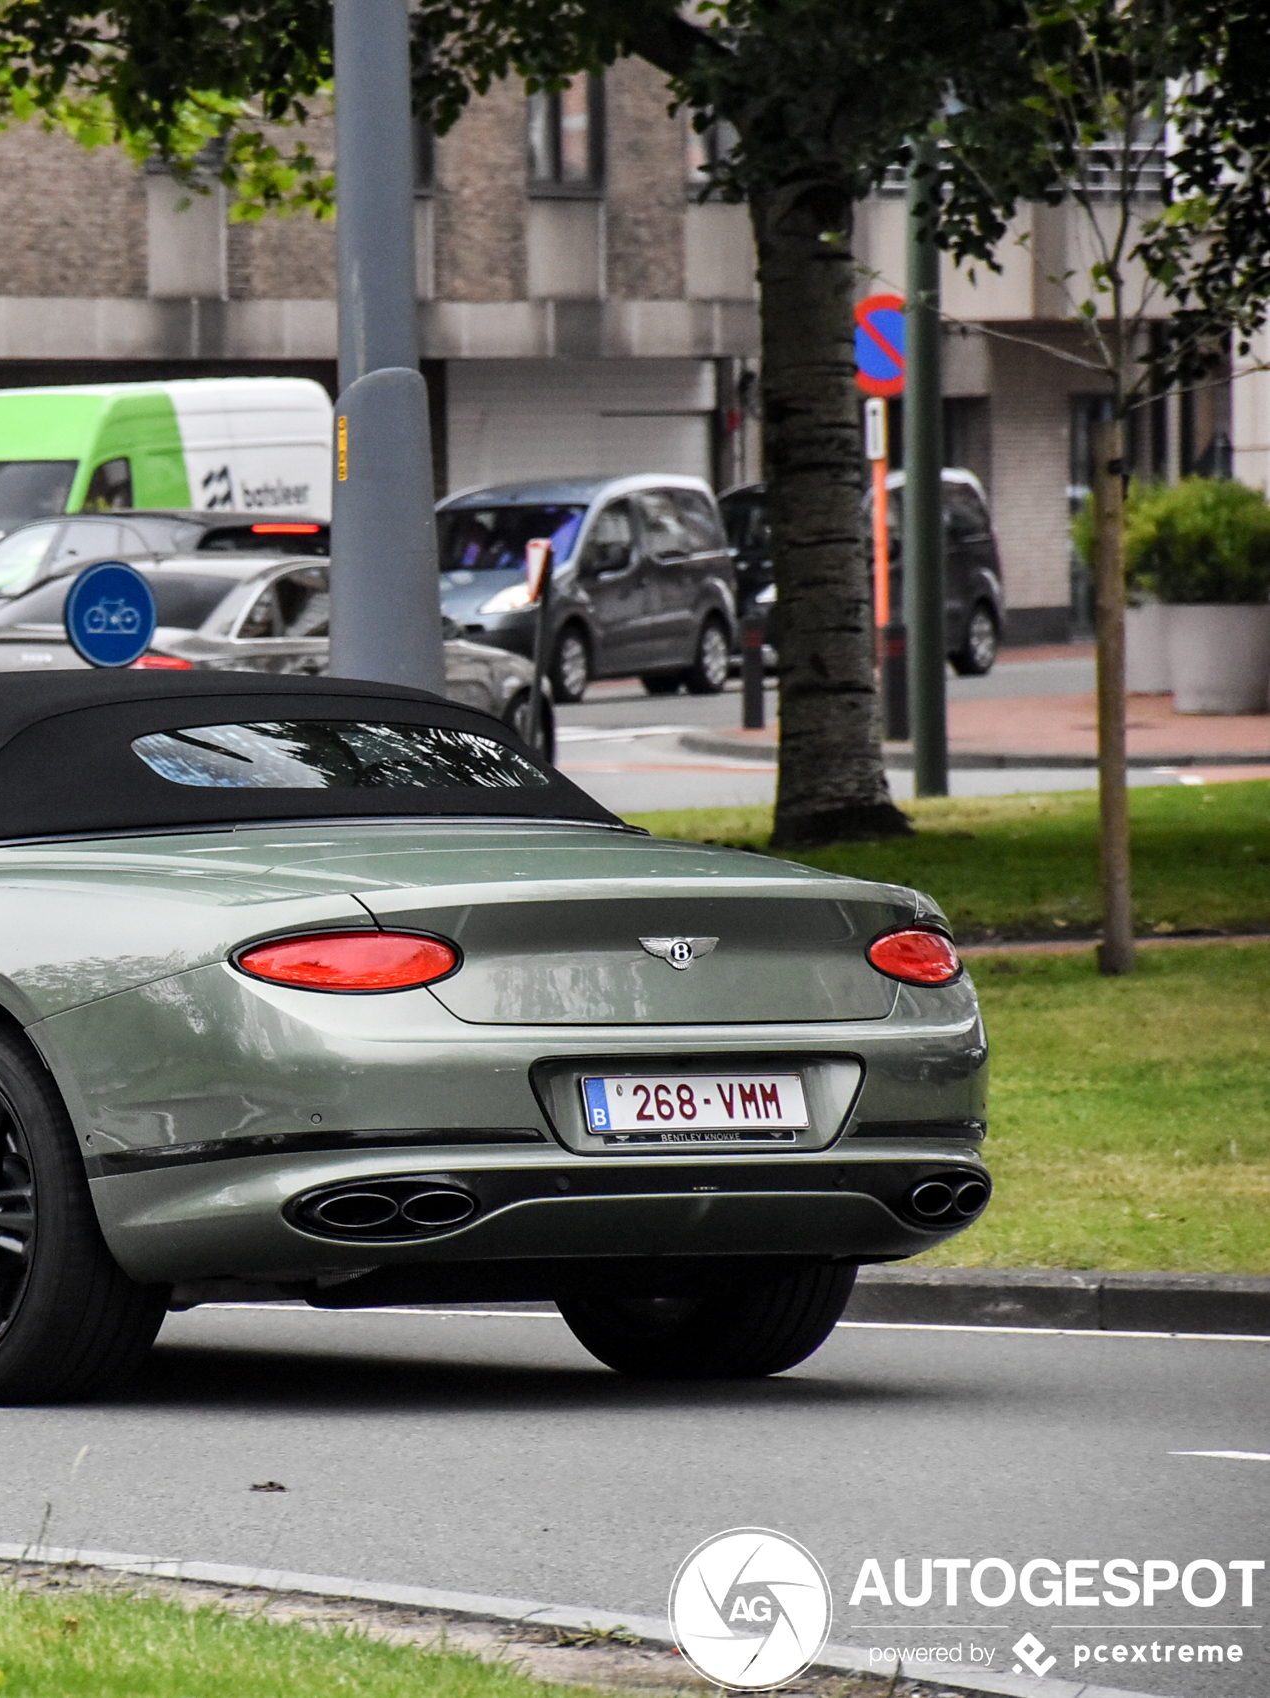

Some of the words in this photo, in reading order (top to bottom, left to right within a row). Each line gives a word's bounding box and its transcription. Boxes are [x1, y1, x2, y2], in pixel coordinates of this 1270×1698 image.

[241, 478, 310, 507] batsleer
[593, 1108, 607, 1126] B
[661, 1133, 702, 1143] BENTLEY
[705, 1132, 742, 1142] KNOKKE
